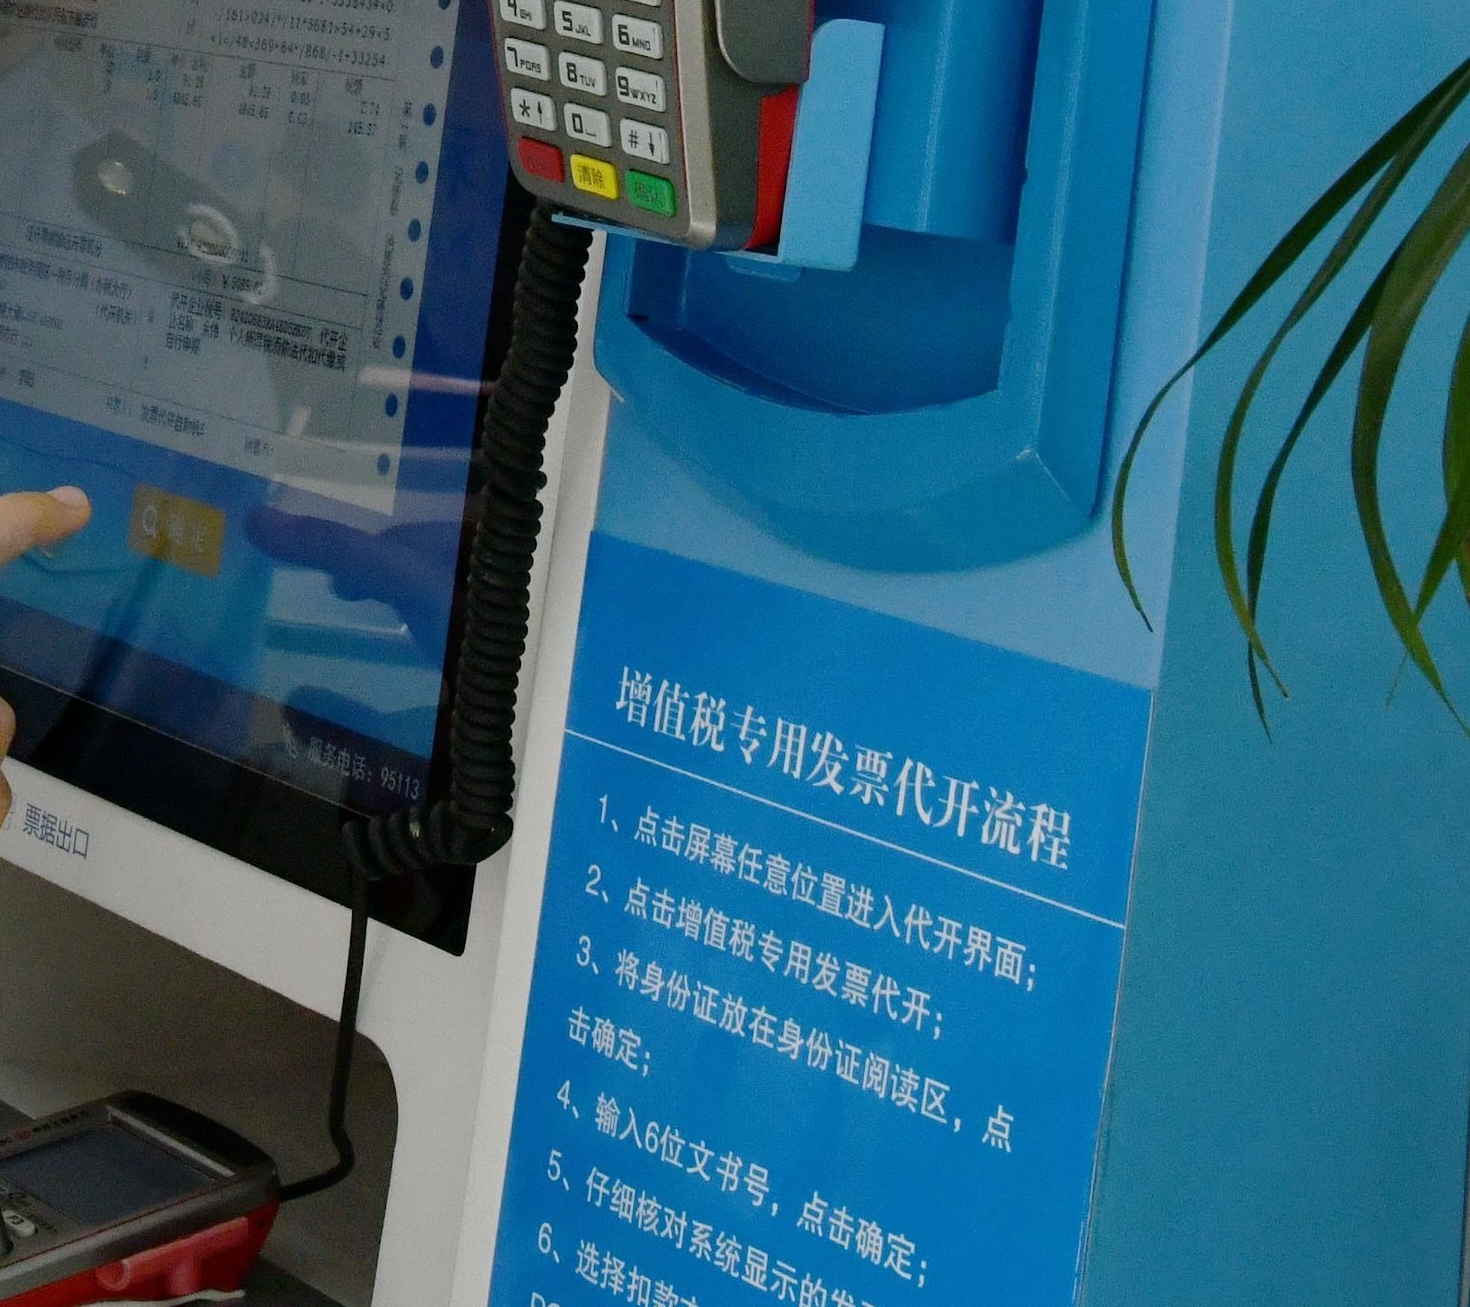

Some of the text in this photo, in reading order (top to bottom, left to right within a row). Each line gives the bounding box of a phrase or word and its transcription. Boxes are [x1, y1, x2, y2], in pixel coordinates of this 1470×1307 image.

[21, 802, 91, 861] 票据出口
[615, 664, 1073, 872] 增值税专用发票代开流程
